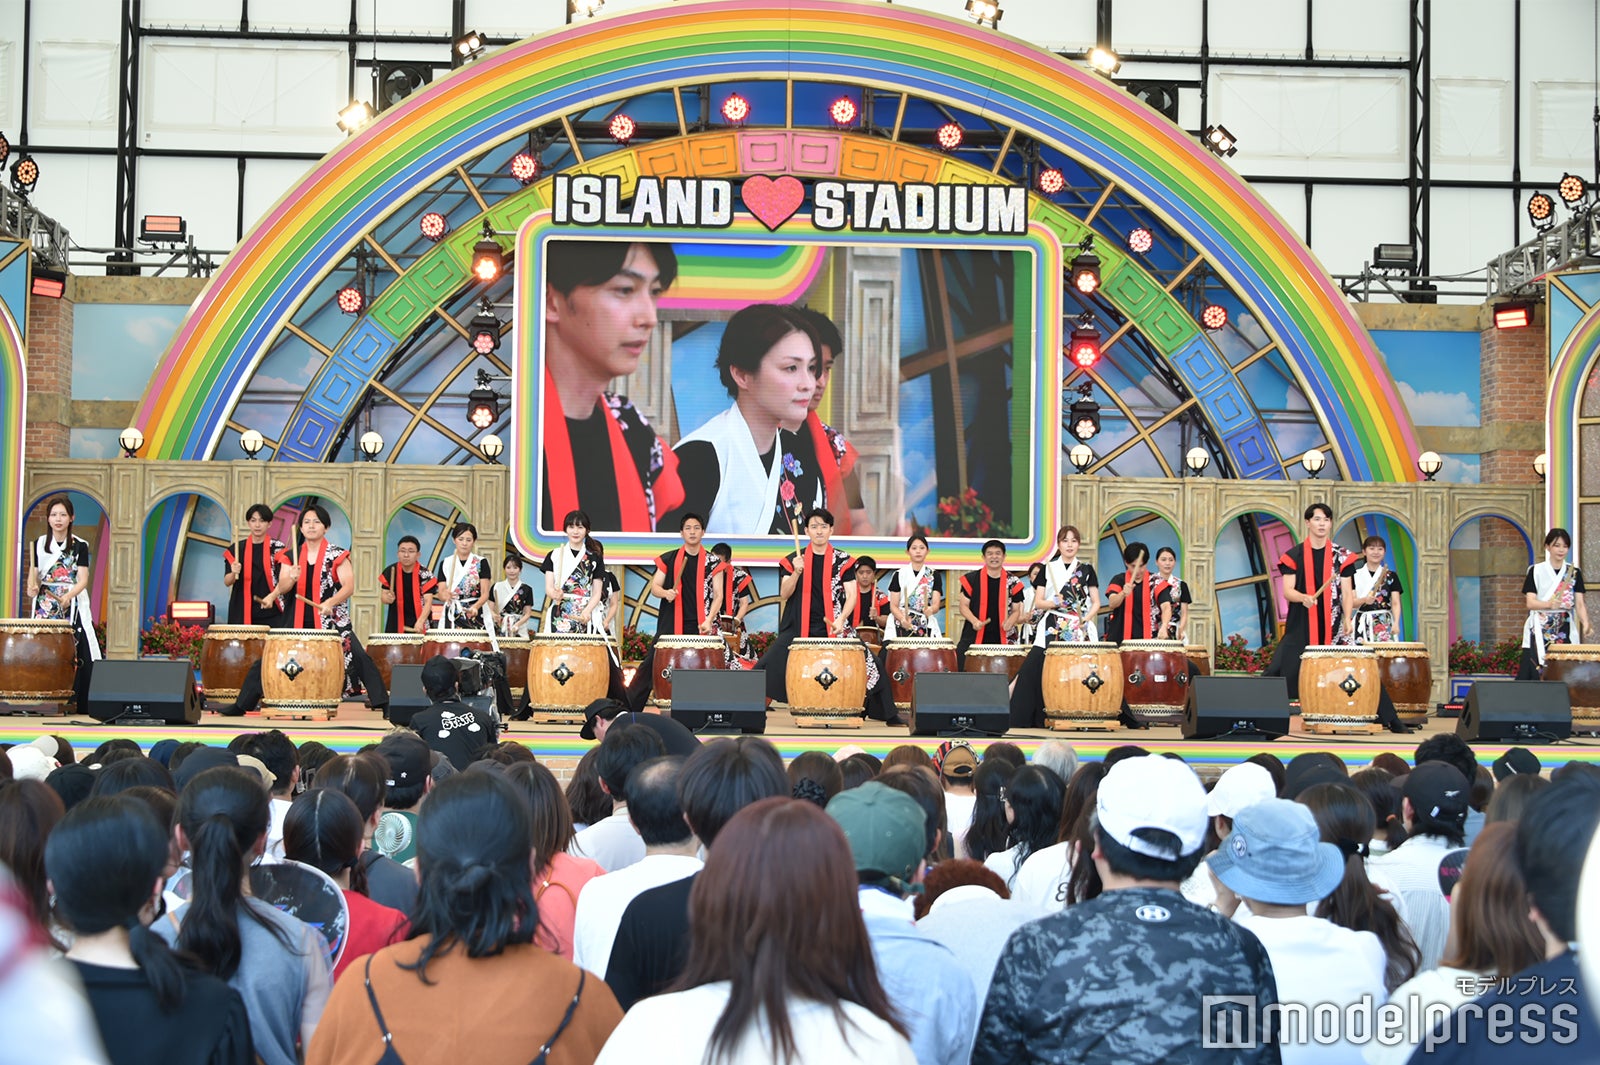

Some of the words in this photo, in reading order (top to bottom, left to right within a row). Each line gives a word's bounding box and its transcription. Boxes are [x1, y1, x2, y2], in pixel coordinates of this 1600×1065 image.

[553, 175, 733, 227] ISLAND
[813, 182, 1027, 233] STADIUM
[442, 712, 475, 730] STAFF
